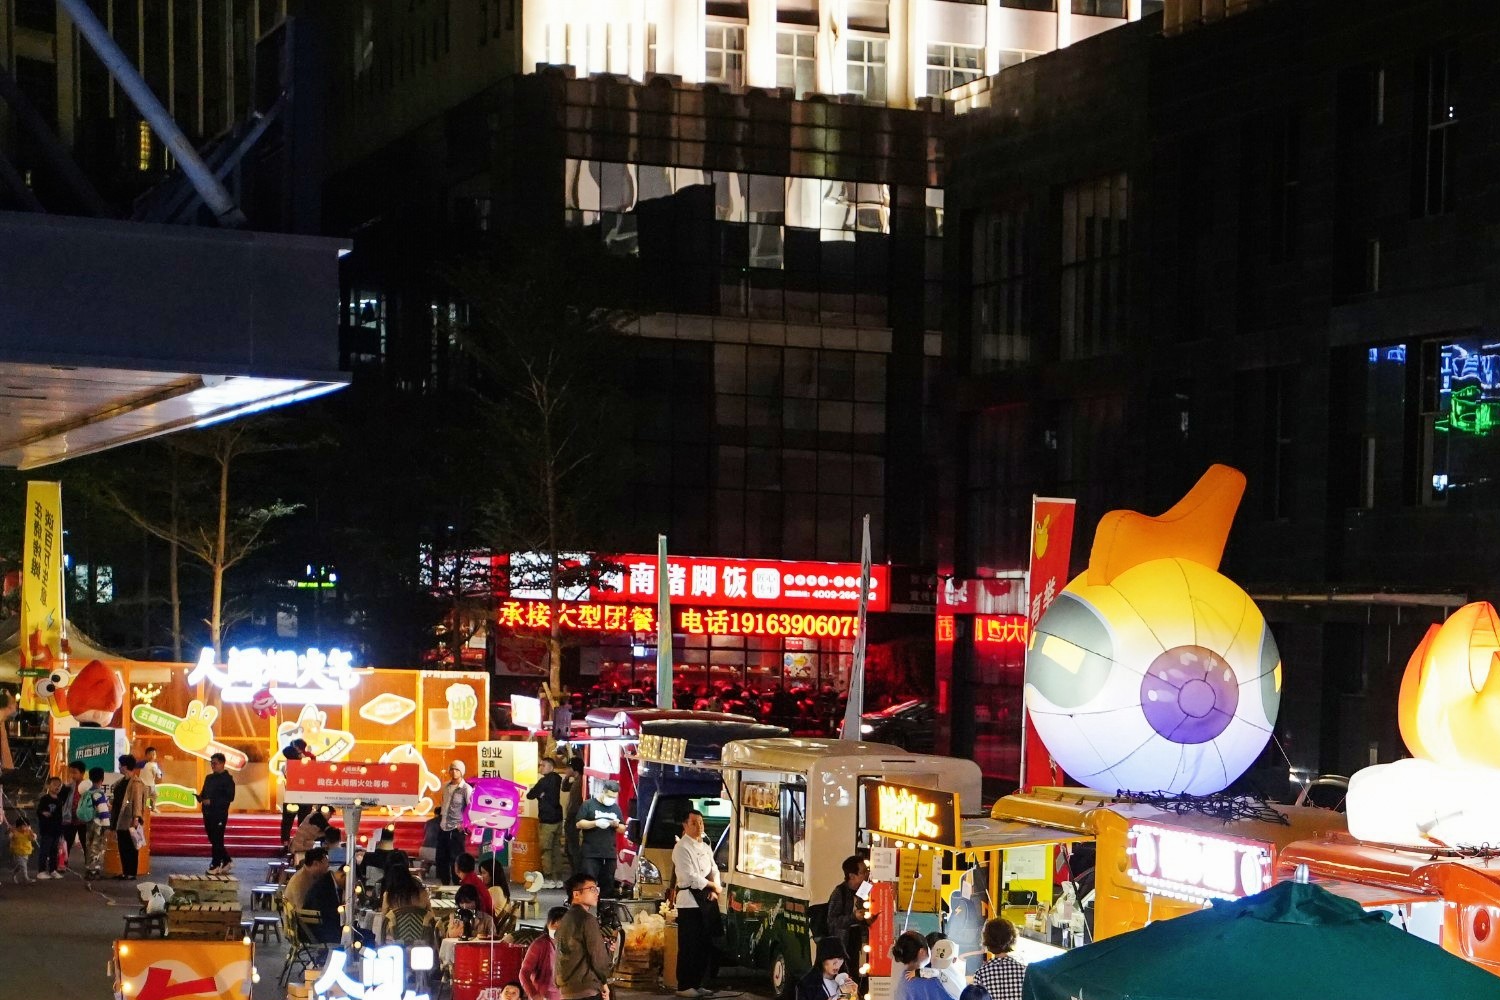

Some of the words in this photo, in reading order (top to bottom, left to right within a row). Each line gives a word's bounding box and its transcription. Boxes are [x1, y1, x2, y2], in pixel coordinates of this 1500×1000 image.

[499, 601, 655, 632] 承接大型团餐
[481, 746, 503, 758] 创业
